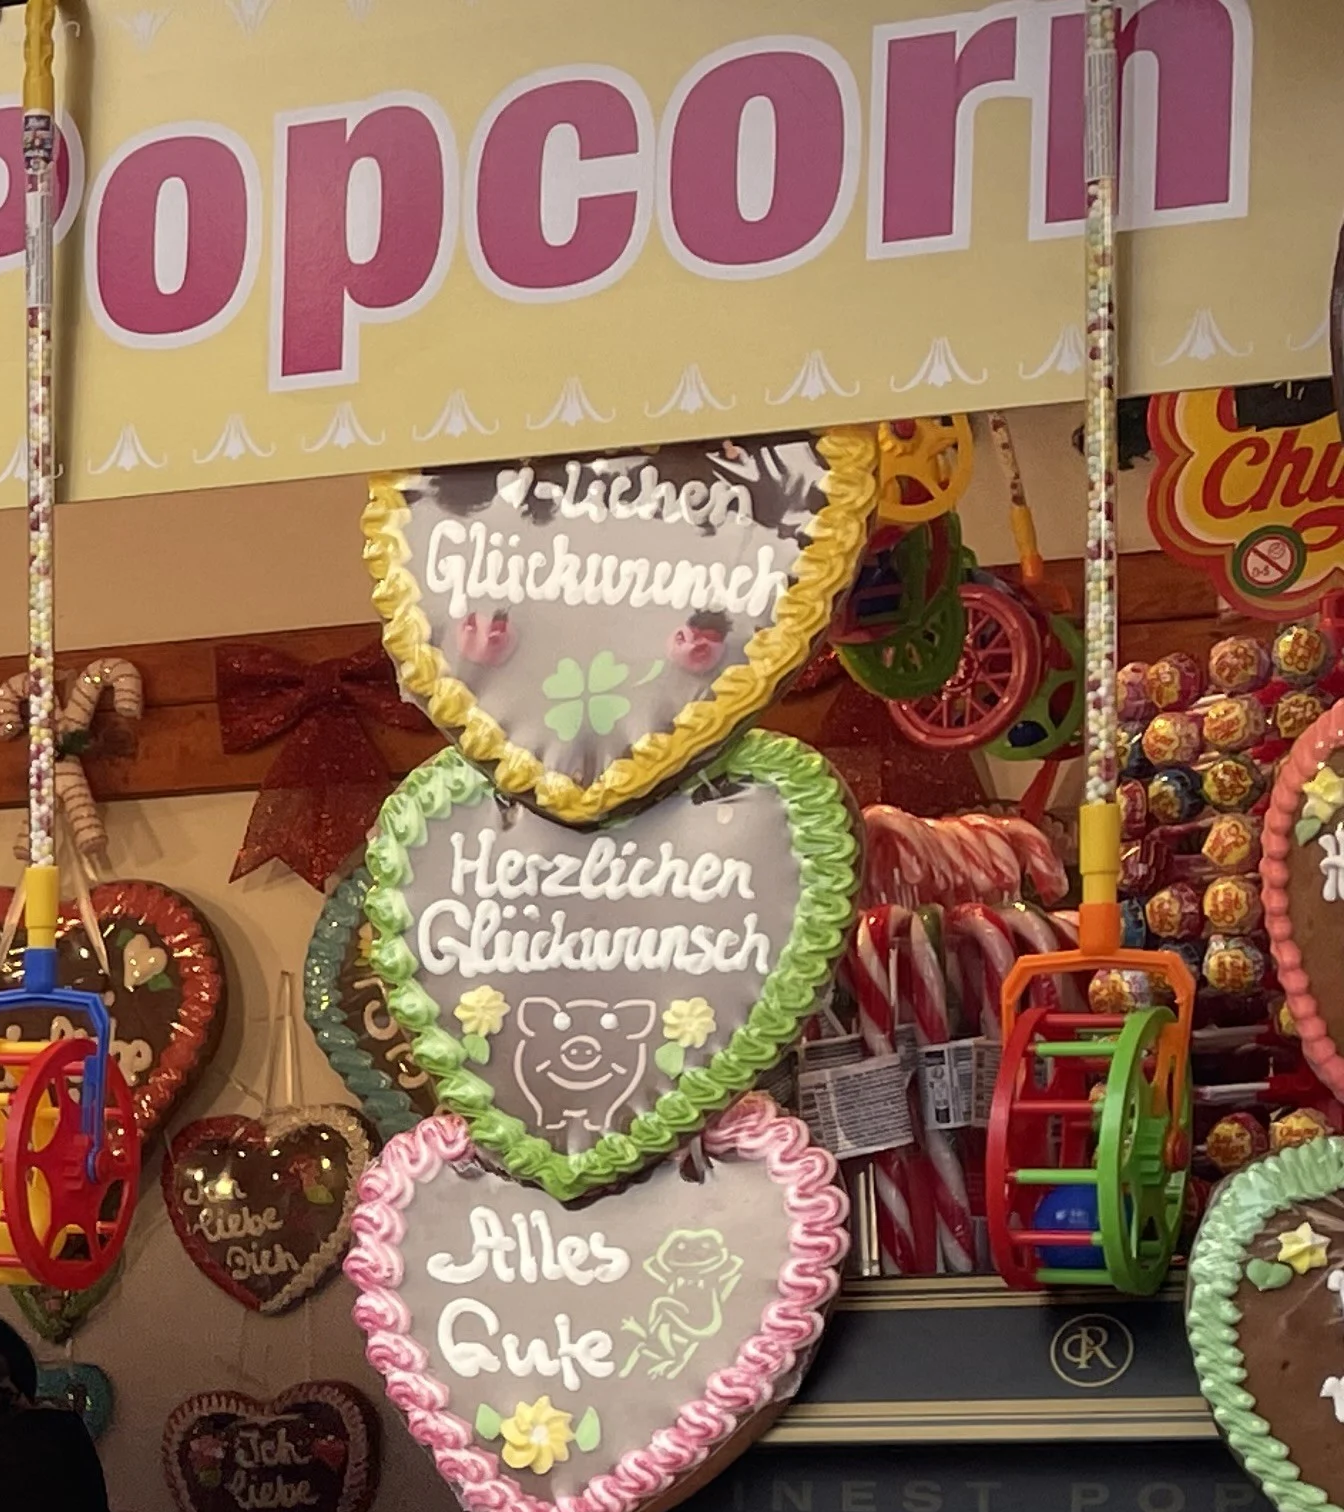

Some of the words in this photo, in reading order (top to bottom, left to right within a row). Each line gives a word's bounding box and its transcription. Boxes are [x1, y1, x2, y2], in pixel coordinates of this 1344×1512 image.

[426, 518, 790, 619] Glückwunsch
[450, 828, 756, 901] Herzlichen
[417, 898, 773, 979] Glückwunsch
[227, 1244, 300, 1278] Dich
[427, 1205, 632, 1286] Alles
[437, 1297, 617, 1392] Gute
[235, 1429, 310, 1469] Ich
